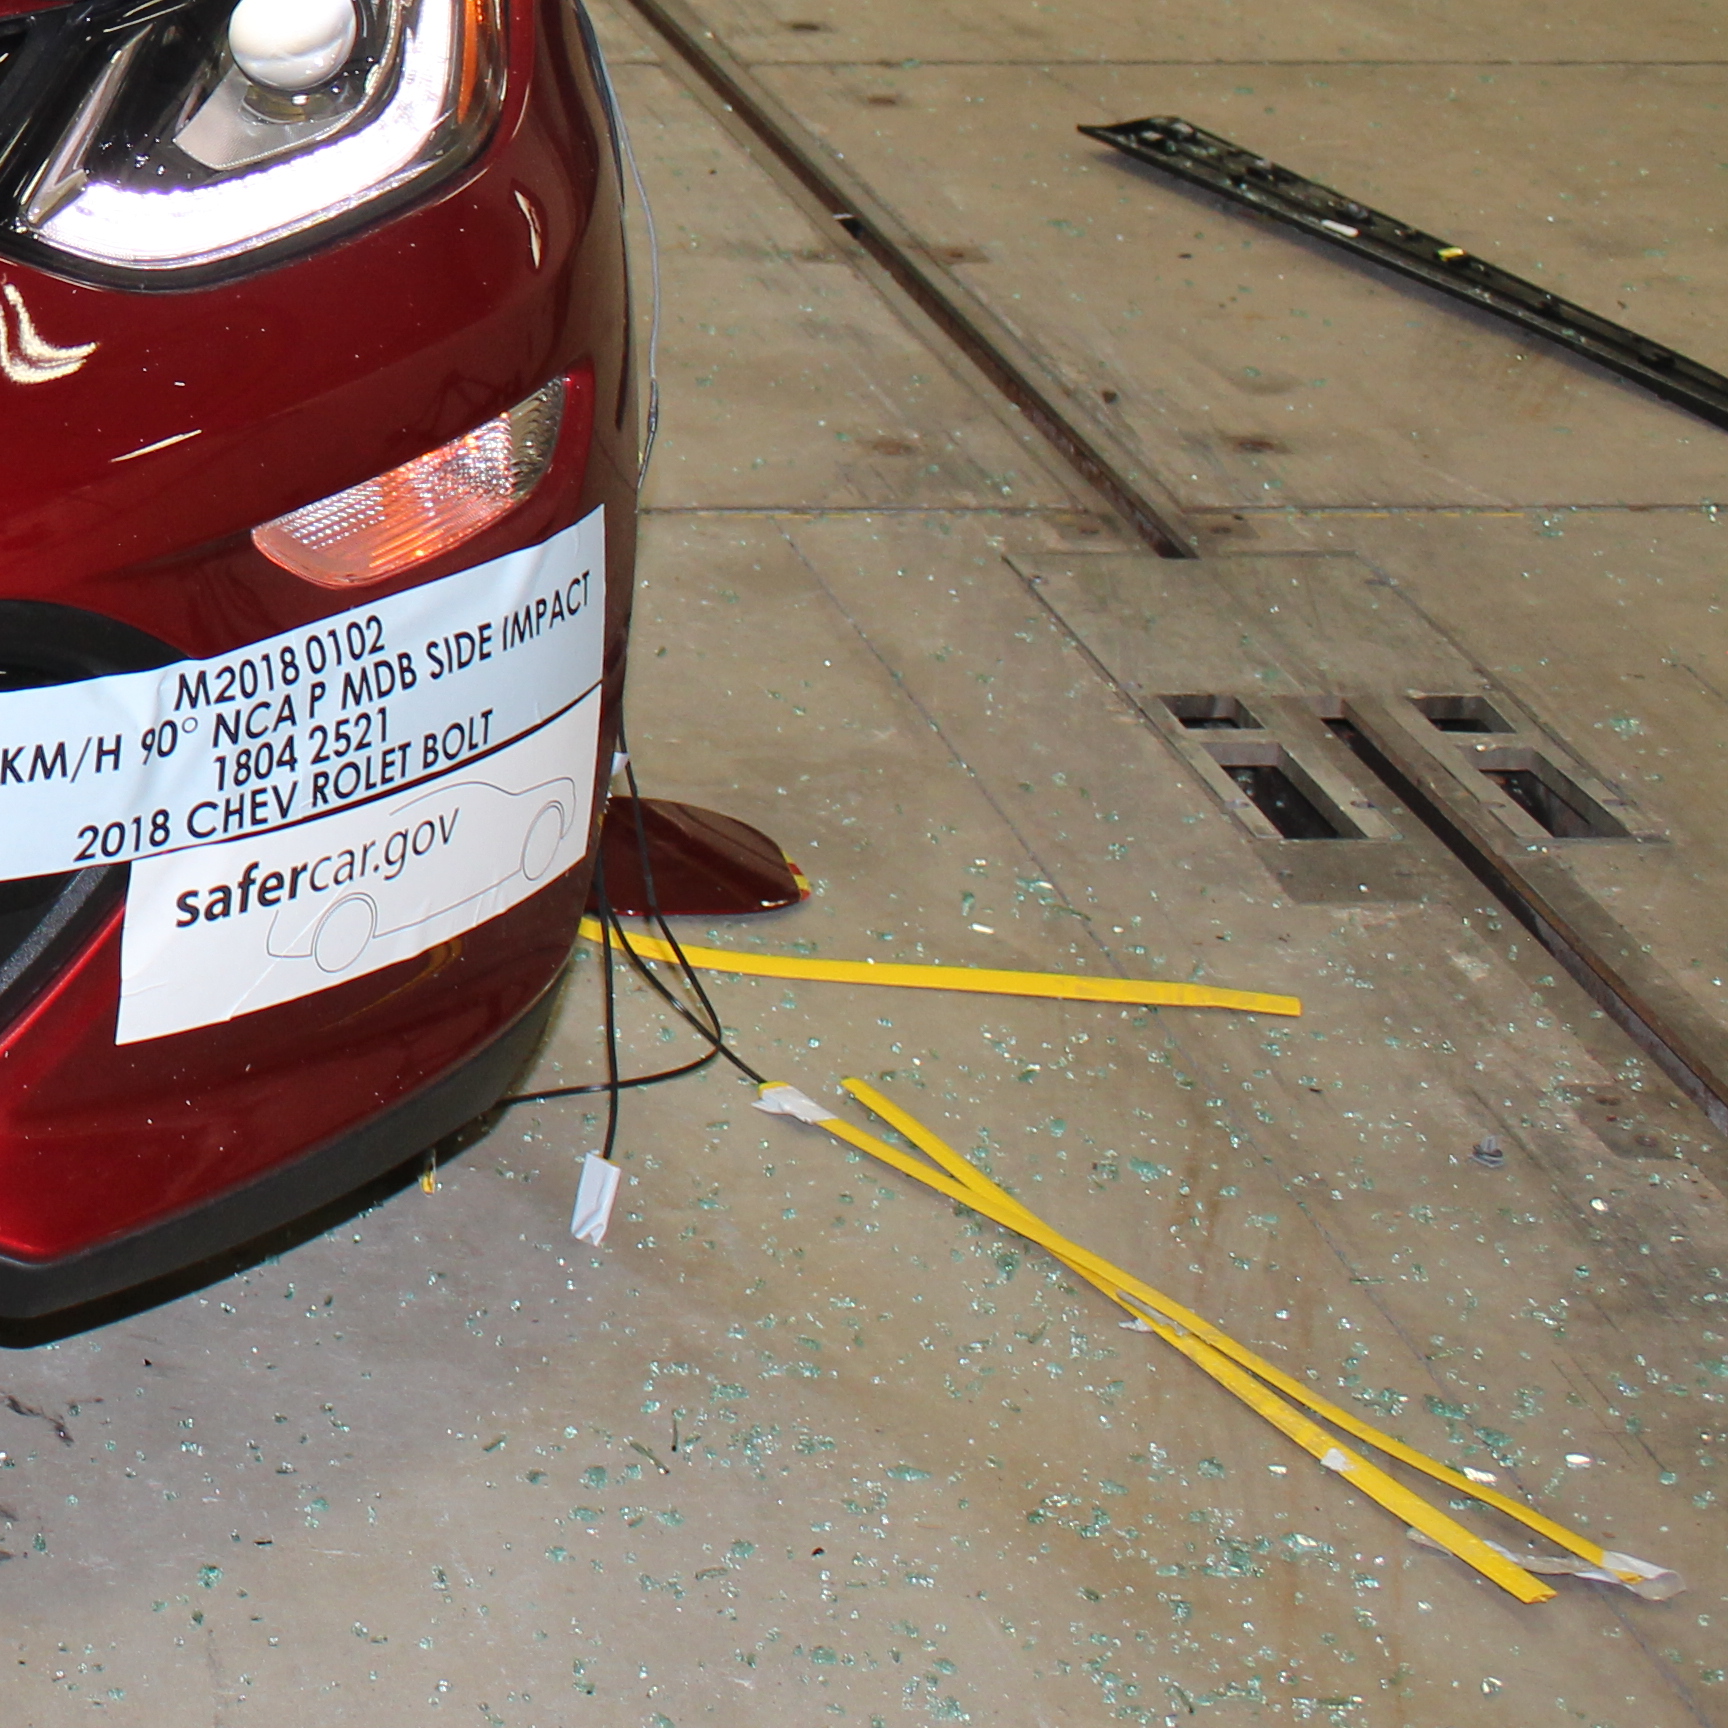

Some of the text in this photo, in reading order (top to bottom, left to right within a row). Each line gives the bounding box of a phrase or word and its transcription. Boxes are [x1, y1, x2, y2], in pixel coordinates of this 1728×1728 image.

[0, 734, 123, 786] KM/H
[341, 651, 418, 711] MDB
[425, 622, 493, 680] SIDE
[501, 569, 591, 653] IMPACT
[73, 808, 171, 863] 2018
[422, 708, 495, 770] BOLT
[176, 808, 460, 928] safercar.gov
